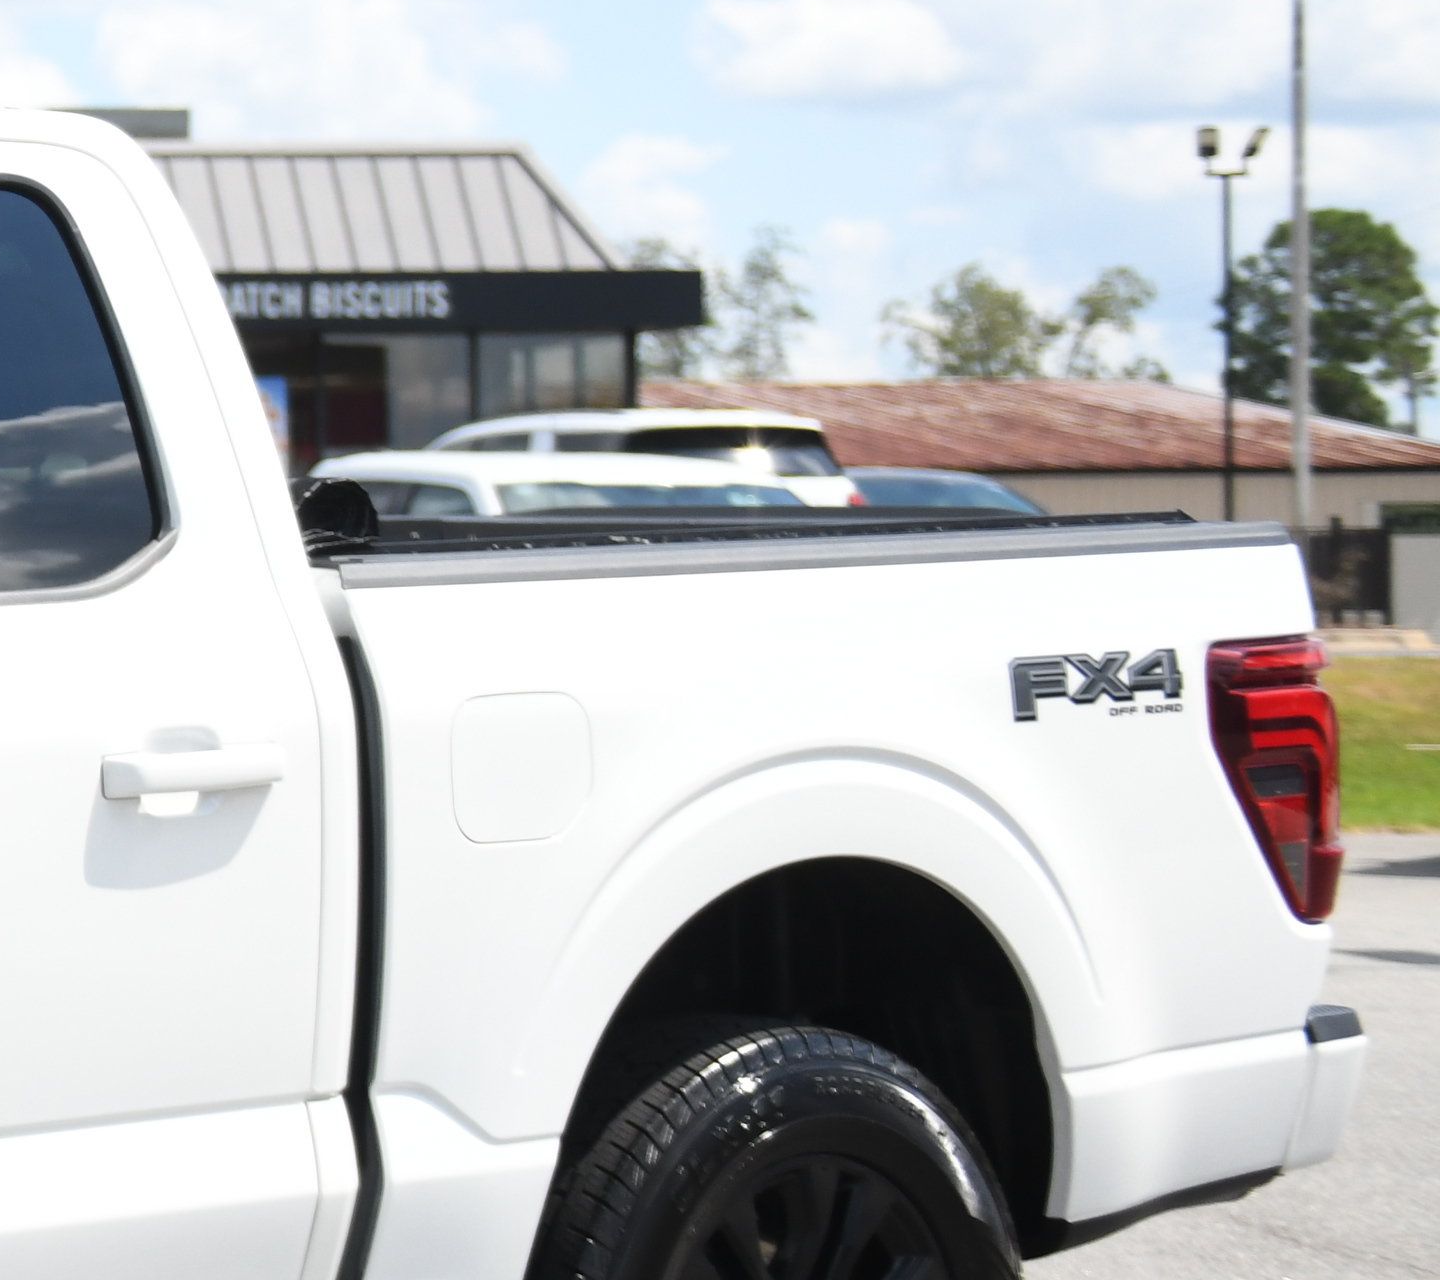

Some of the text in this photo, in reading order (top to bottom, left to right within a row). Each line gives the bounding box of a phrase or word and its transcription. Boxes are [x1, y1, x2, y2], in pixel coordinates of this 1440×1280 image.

[221, 280, 451, 320] ATCH BISCUITS
[1008, 648, 1183, 722] FX4
[1109, 703, 1183, 716] OFF ROAD
